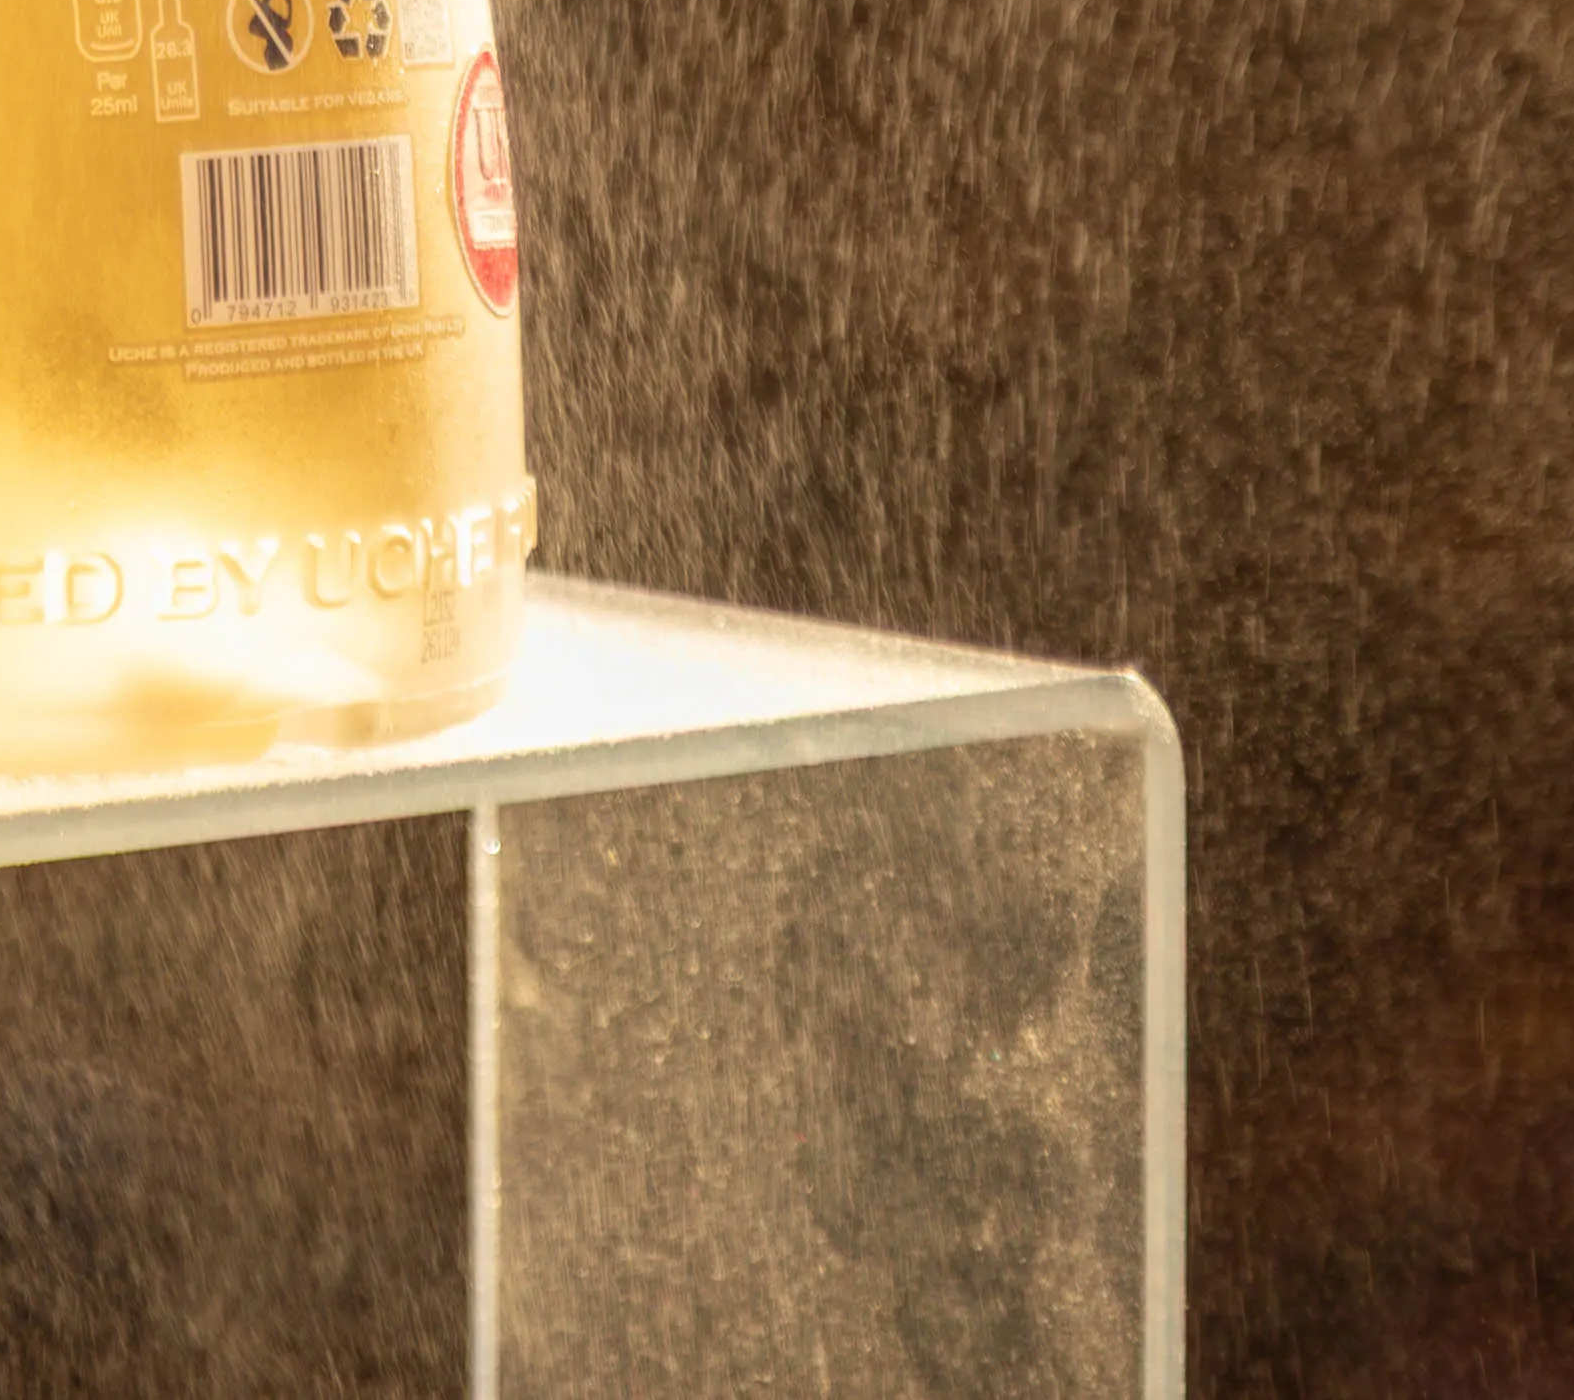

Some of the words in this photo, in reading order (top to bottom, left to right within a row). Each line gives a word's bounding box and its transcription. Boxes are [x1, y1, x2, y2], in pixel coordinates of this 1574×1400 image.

[100, 11, 119, 25] UK
[97, 71, 128, 92] Per
[90, 94, 138, 117] 25ml
[228, 96, 311, 116] SUITABLE
[314, 93, 345, 110] FOR
[191, 308, 202, 325] 0
[227, 301, 297, 321] 794712
[109, 345, 157, 363] UCHE
[160, 344, 175, 359] IS
[178, 343, 190, 358] A
[194, 335, 287, 356] REGISTERED
[290, 328, 370, 348] TRADEMARK
[185, 357, 270, 378] PRODUCED
[274, 354, 306, 371] AND
[307, 349, 364, 367] BOTTLED
[153, 534, 279, 623] BY
[299, 505, 495, 612] UCHE
